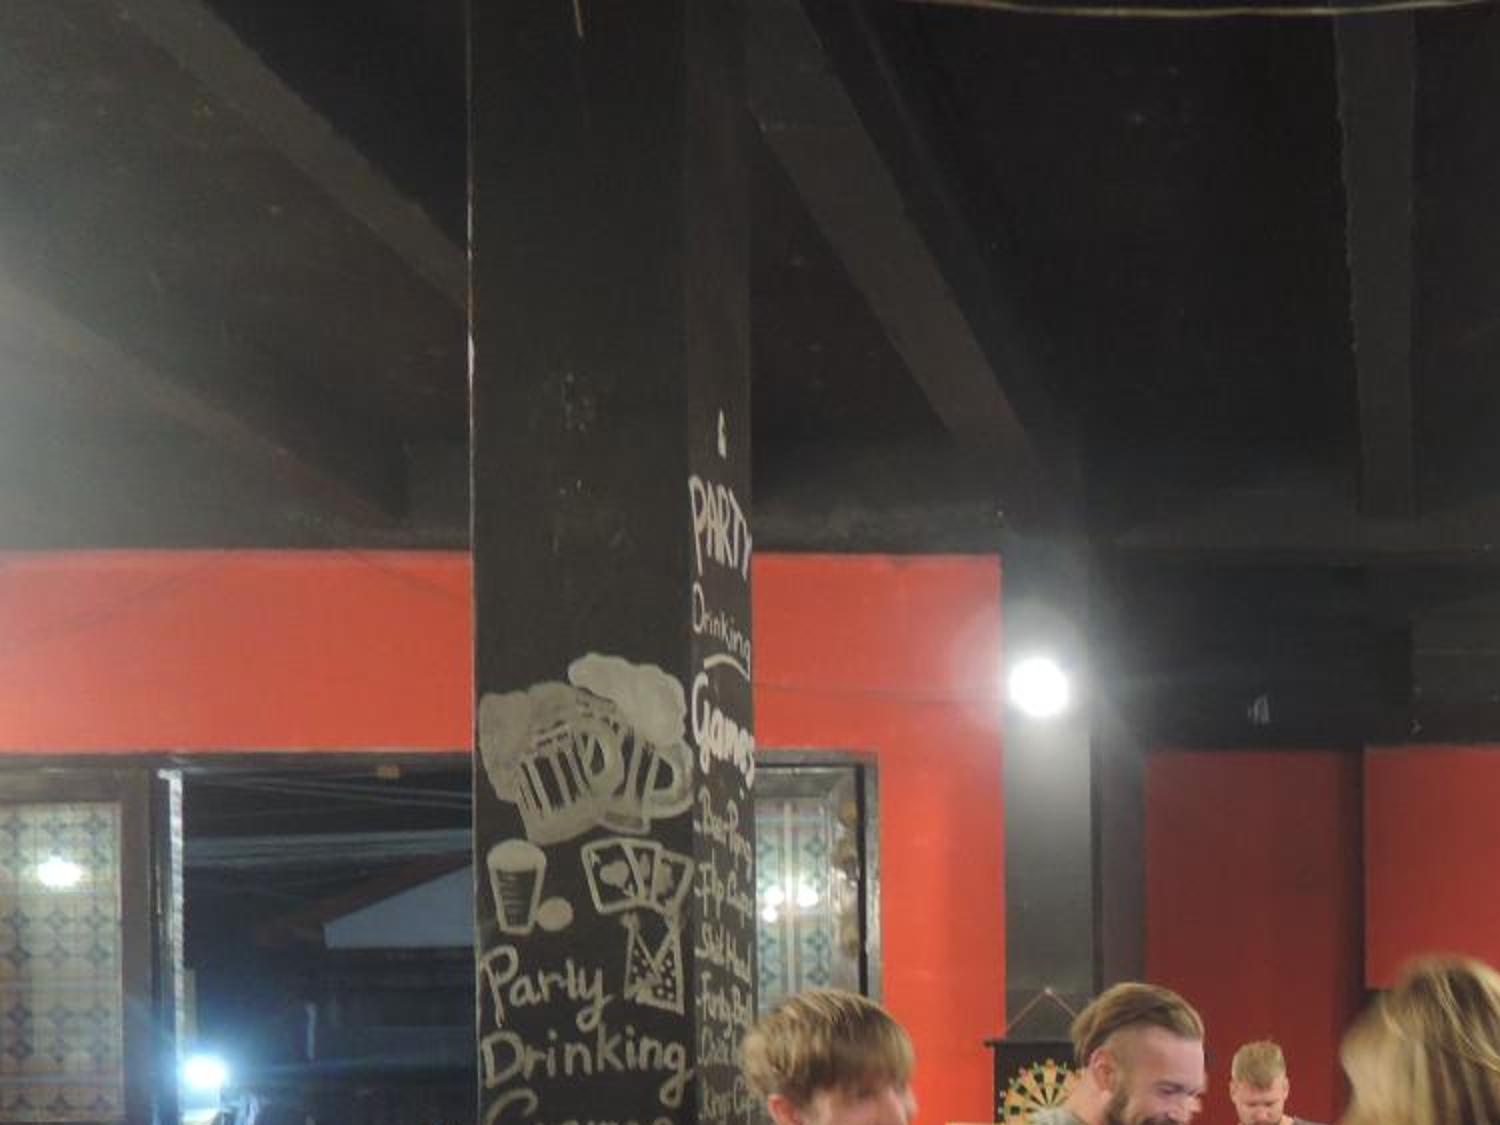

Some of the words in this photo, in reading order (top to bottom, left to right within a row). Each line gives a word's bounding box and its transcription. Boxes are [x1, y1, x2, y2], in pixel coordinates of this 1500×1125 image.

[688, 474, 752, 580] PARTY
[692, 583, 752, 672] Drinking
[479, 945, 613, 1033] Party
[480, 1026, 694, 1109] Drinking
